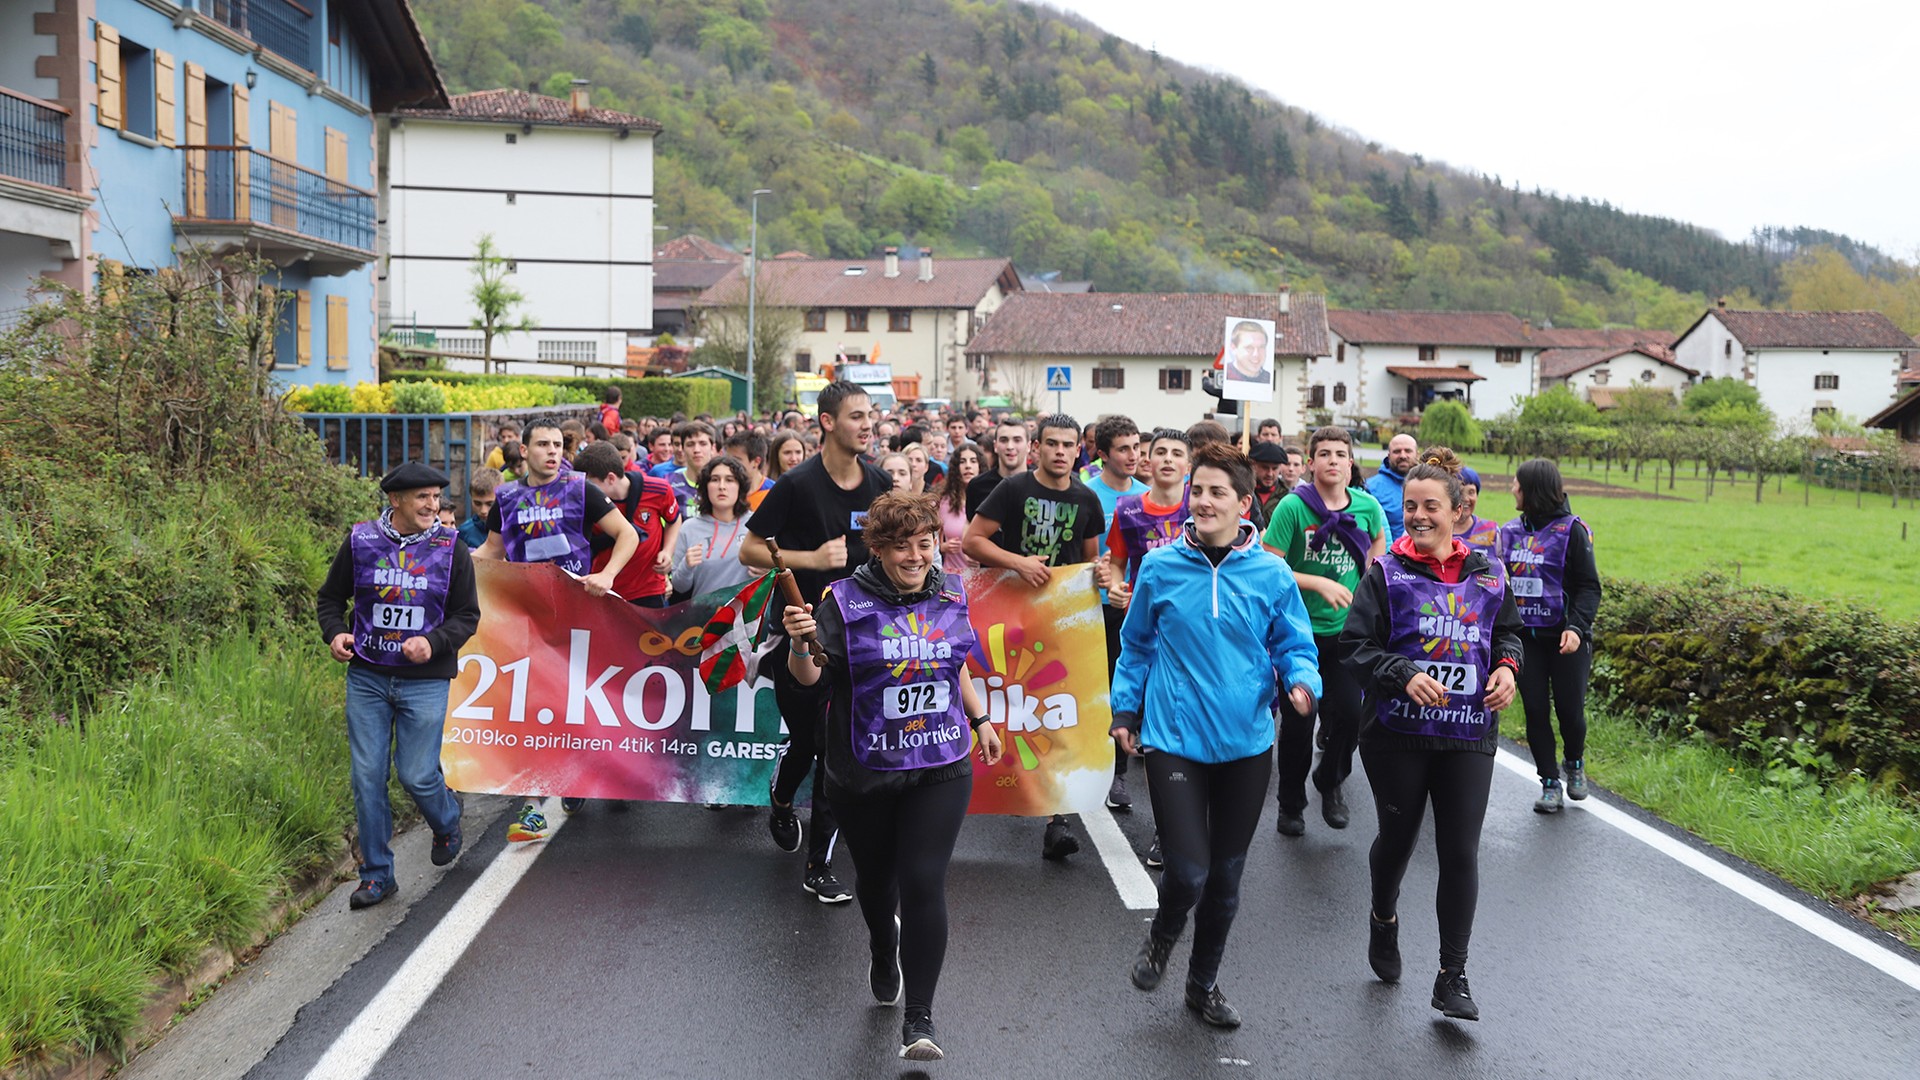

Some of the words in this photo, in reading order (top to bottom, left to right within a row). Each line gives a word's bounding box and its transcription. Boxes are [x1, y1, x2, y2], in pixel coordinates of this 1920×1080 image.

[517, 505, 564, 524] Klika
[1509, 548, 1545, 565] Klika
[373, 568, 428, 590] Klika
[857, 600, 874, 609] eitb
[382, 606, 413, 628] 971
[1418, 614, 1481, 643] Klika
[882, 634, 952, 661] Klika
[1426, 664, 1467, 692] 972
[898, 684, 937, 715] 972
[971, 675, 1079, 733] lika
[904, 715, 928, 733] aek
[1418, 704, 1486, 725] korrika
[450, 726, 518, 747] 2019ko
[523, 732, 613, 751] apirilaren
[618, 736, 655, 754] 4tik
[660, 738, 698, 755] 14ra
[867, 732, 896, 751] 21.
[898, 723, 962, 749] korrika
[995, 772, 1019, 788] aek
